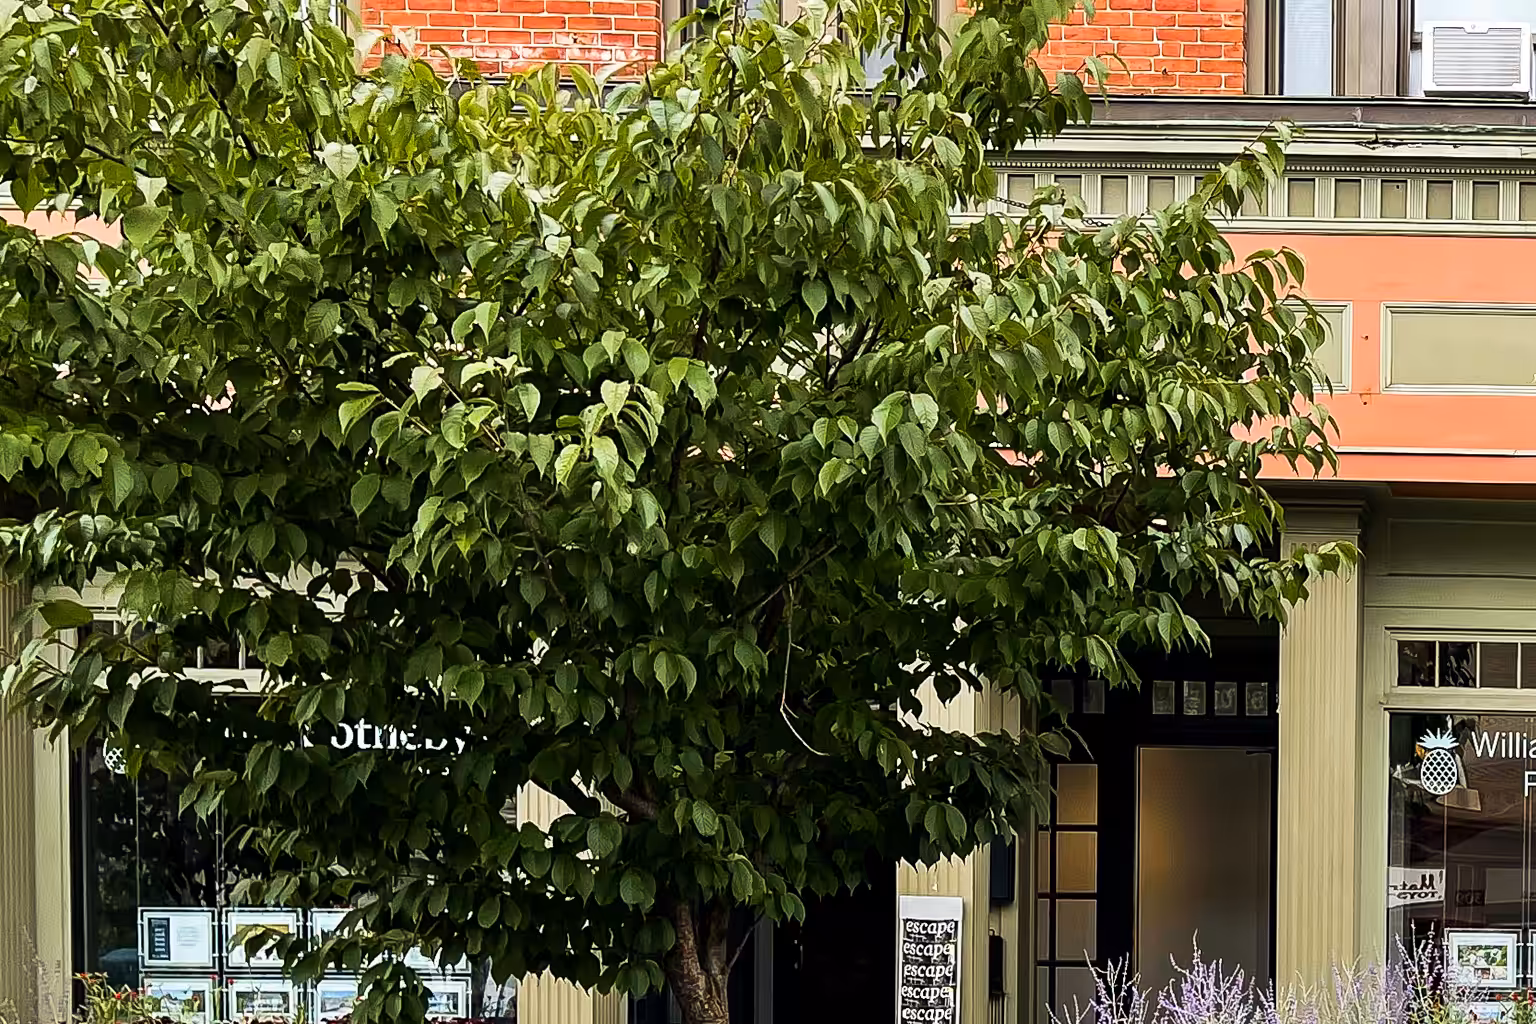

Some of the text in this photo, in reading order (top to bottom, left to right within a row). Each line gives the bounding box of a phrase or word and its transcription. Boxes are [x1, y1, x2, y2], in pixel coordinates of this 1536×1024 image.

[905, 920, 956, 938] escape
[903, 942, 951, 960] escape
[903, 963, 954, 981] escape
[901, 985, 951, 1003] escape
[902, 1007, 952, 1024] escape
